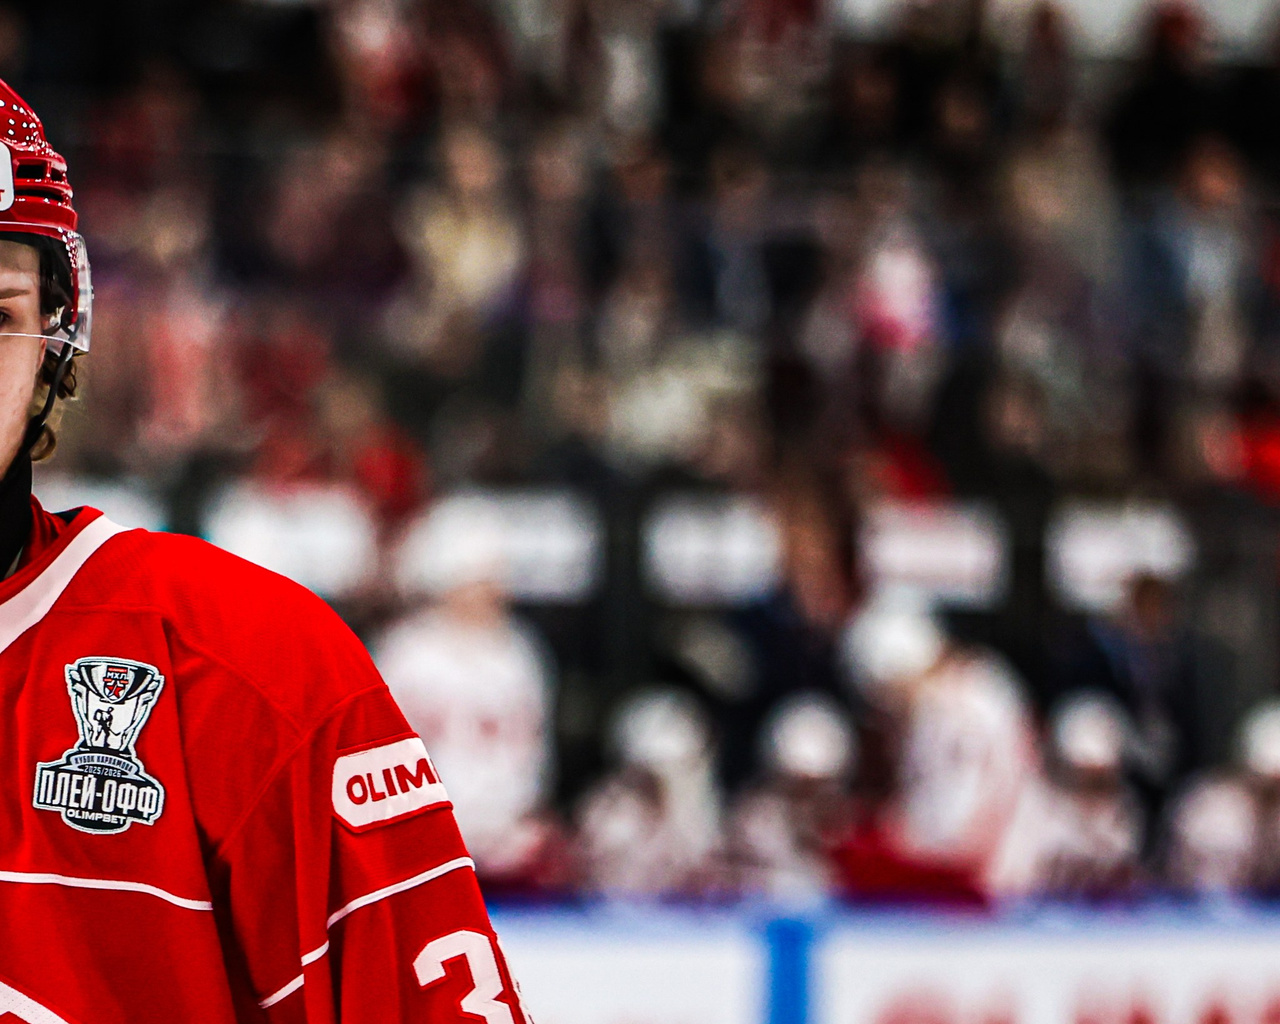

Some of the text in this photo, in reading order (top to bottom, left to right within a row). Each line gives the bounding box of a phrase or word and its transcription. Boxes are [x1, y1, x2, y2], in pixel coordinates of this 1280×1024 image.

[106, 671, 127, 680] МХЛ
[39, 769, 158, 818] ПЛЕЙ-ОФФ
[347, 757, 443, 805] OLIM
[66, 808, 127, 824] OLIMPBET
